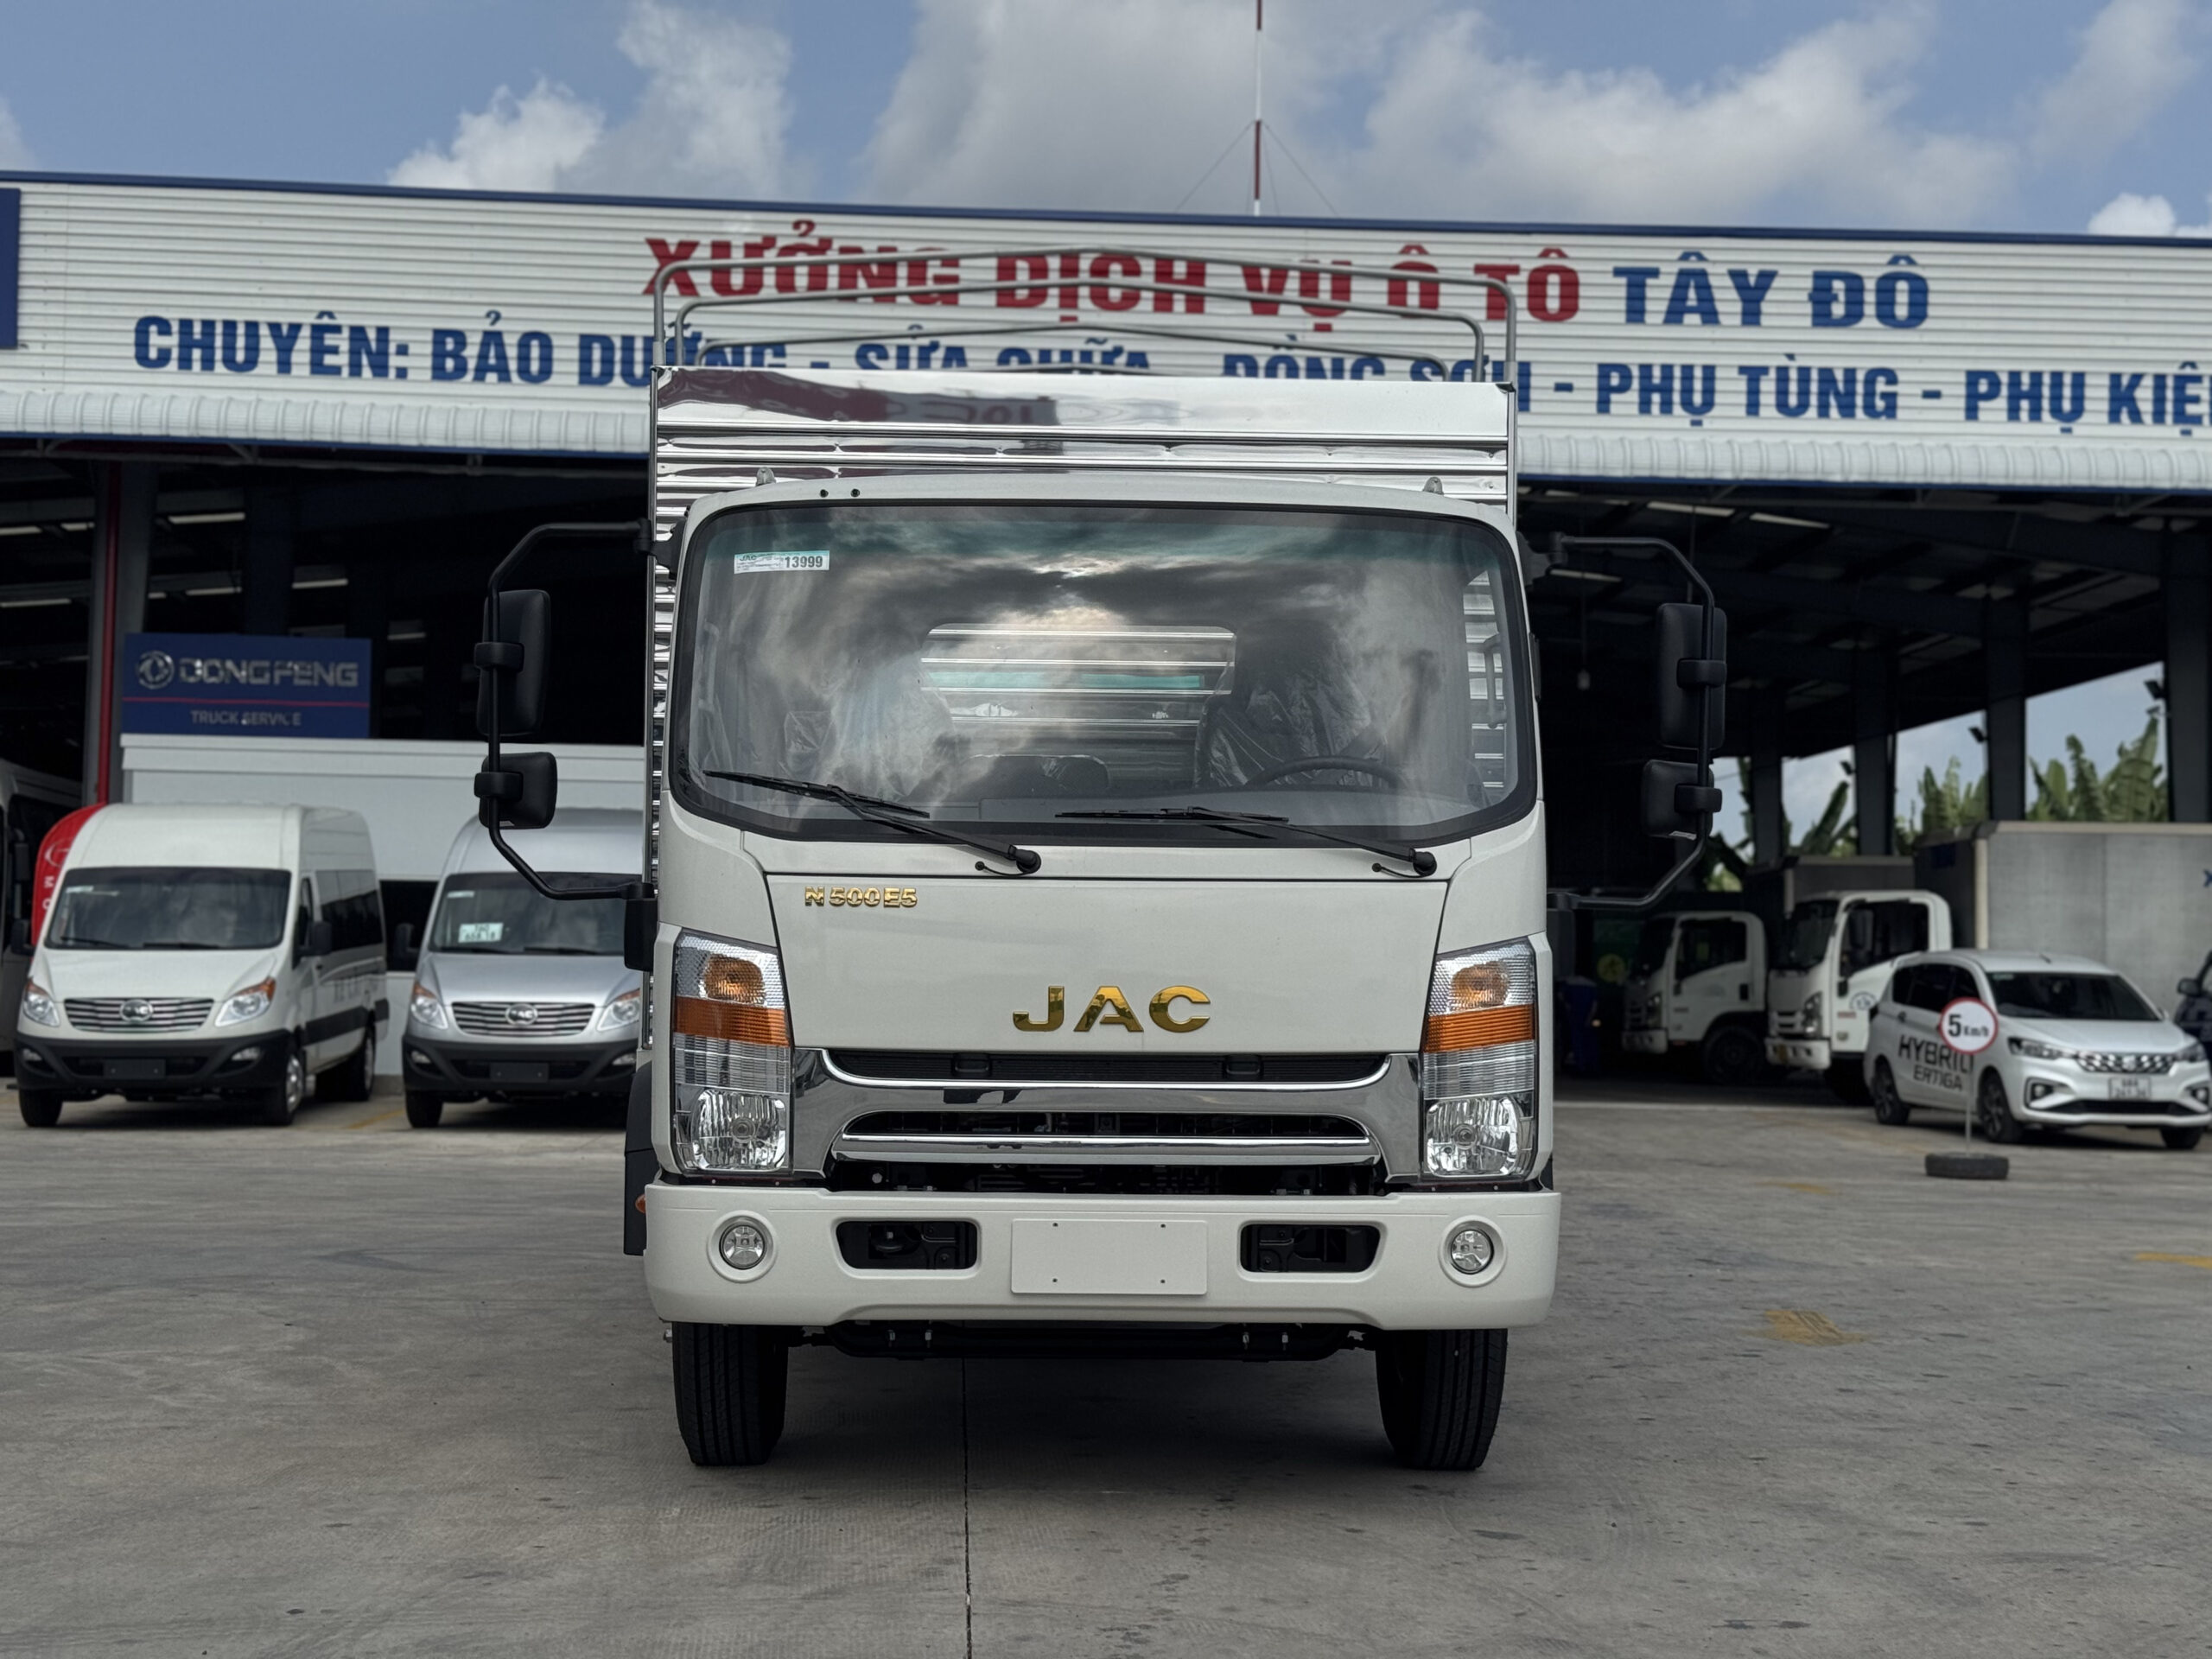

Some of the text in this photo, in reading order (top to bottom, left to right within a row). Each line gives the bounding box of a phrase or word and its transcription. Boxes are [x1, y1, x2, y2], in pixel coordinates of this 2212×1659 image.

[642, 219, 1929, 332] XƯỞNG DỊCH VỤ Ô TÔ TÂY ĐÔ
[134, 310, 409, 379] CHUYÊN:
[431, 310, 553, 385] BẢO
[1596, 363, 1716, 427] PHỤ
[1738, 353, 1898, 420] TÙNG
[1964, 370, 2086, 435] PHỤ
[2108, 361, 2212, 436] KIỆ
[785, 556, 823, 569] 13999
[179, 658, 359, 688] DONGFENG
[190, 709, 239, 725] TRUCK
[1013, 985, 1211, 1033] JAC
[1948, 1014, 1961, 1037] 5
[1913, 1064, 1963, 1091] ERTIGA
